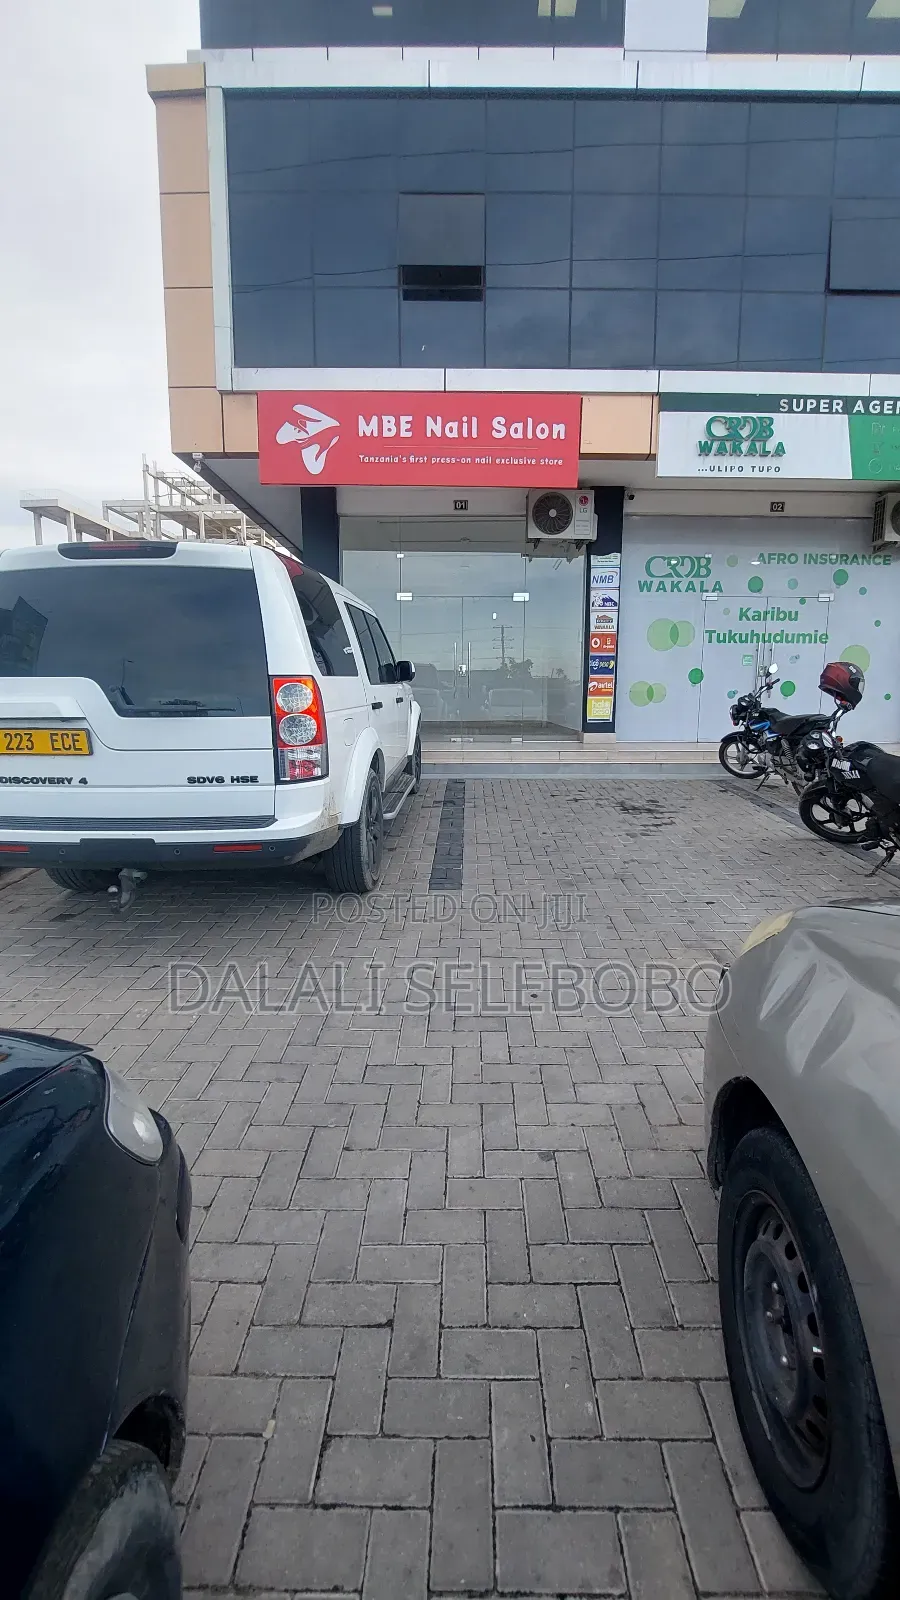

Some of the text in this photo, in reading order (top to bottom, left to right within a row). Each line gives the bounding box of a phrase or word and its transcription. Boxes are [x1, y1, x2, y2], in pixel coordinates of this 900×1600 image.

[779, 398, 843, 413] SUPER
[358, 415, 566, 440] MBE Nail Salon
[705, 415, 775, 441] CRDB
[697, 440, 786, 457] WAKALA
[359, 454, 563, 466] Tanzania's first press-on nail exclusive store
[751, 465, 781, 473] TUPO
[772, 503, 783, 511] 02
[757, 552, 892, 566] AFRO INSURANCE
[645, 555, 712, 578] CRDB
[592, 575, 614, 584] NMB
[638, 580, 723, 593] WAKALA
[738, 607, 799, 622] Karibu
[705, 629, 829, 644] Tukuhudumie
[4, 732, 83, 751] 223 ECE
[0, 776, 88, 785] DISCOVERY 4
[187, 775, 259, 784] SDV6 HSE
